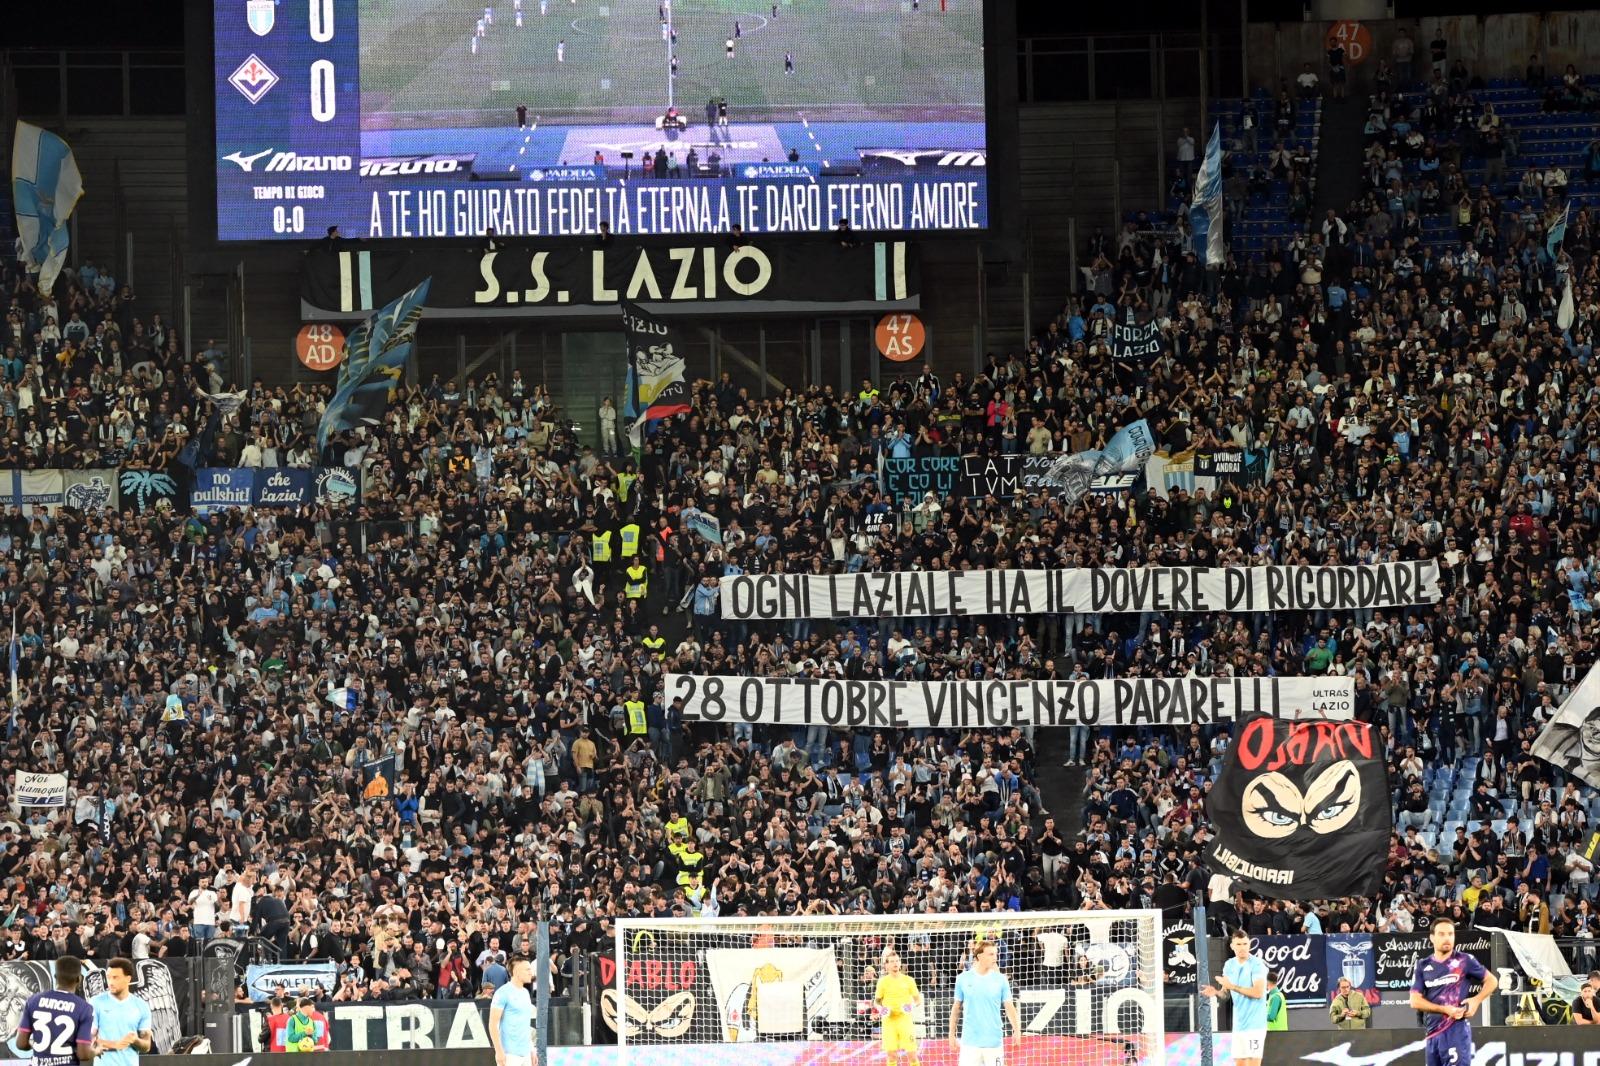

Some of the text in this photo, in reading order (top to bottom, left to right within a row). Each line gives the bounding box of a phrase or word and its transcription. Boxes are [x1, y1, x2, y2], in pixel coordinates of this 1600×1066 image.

[1336, 23, 1360, 41] 47
[310, 59, 336, 122] 0
[253, 185, 325, 200] TEMPO DI GIOCO
[369, 191, 383, 237] A
[388, 190, 412, 237] TE
[418, 189, 448, 237] HO
[454, 188, 540, 236] GIURATO
[547, 178, 631, 235] FEDELTÀ
[736, 185, 760, 232] TE
[766, 175, 820, 232] DARÒ
[828, 183, 903, 231] ETERNO
[911, 182, 979, 230] AMORE
[273, 206, 304, 234] 0:0
[474, 245, 772, 303] S.S. LAZIO
[307, 324, 333, 342] 48
[886, 315, 912, 334] 47
[1114, 319, 1160, 342] FORZA
[305, 345, 336, 364] AD
[885, 336, 913, 356] AS
[1215, 462, 1240, 473] ANDRAI
[213, 473, 231, 485] no
[267, 471, 291, 487] che
[732, 560, 1434, 619] OGNI LAZIALE HA IL DOVERE DI RICORDARE
[676, 675, 727, 721] 28
[740, 677, 909, 727] OTTOBRE
[921, 679, 1100, 727] VINCENZO
[1312, 689, 1349, 698] ULTRAS
[1312, 701, 1350, 711] LAZIO
[24, 774, 48, 783] Noi
[16, 784, 48, 795] siamo
[599, 956, 697, 991] DABLO
[29, 1010, 76, 1055] 32
[1249, 1039, 1259, 1050] 13
[1448, 1047, 1458, 1063] 5
